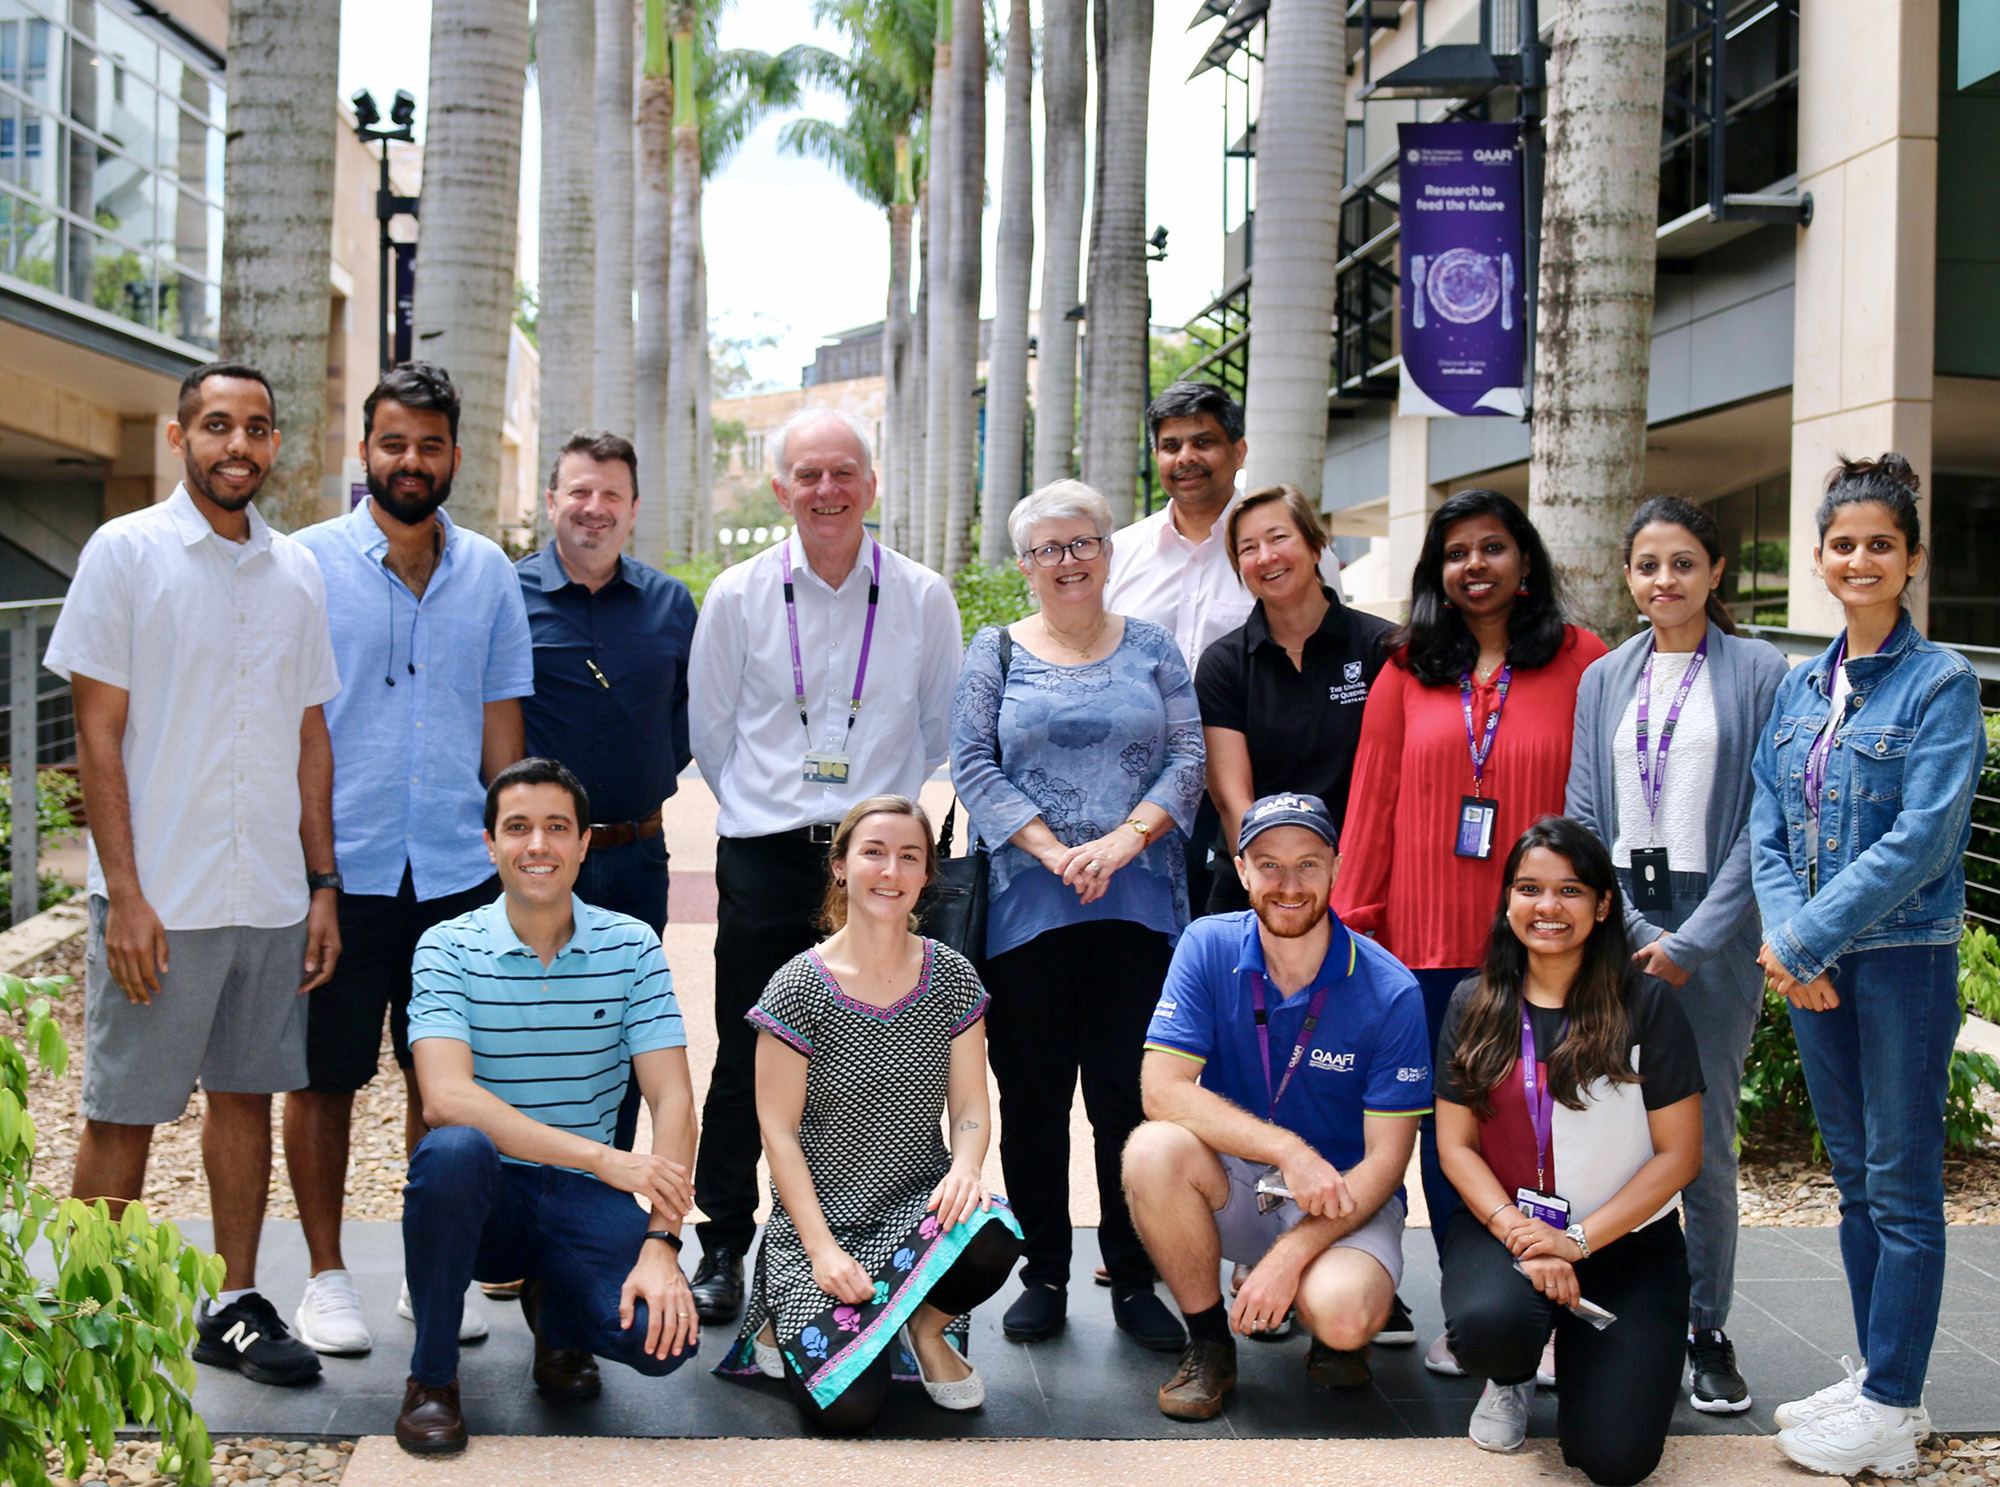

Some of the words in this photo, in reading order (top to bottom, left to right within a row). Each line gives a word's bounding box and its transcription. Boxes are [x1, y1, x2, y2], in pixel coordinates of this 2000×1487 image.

[1473, 149, 1512, 161] QAAFI
[1424, 184, 1480, 197] Research
[1482, 185, 1496, 197] to
[1416, 198, 1444, 211] feed
[1445, 199, 1467, 211] the
[1468, 198, 1505, 212] future
[1254, 796, 1298, 815] QAAFI
[1311, 1048, 1355, 1066] QAAFI
[221, 1320, 260, 1353] N
